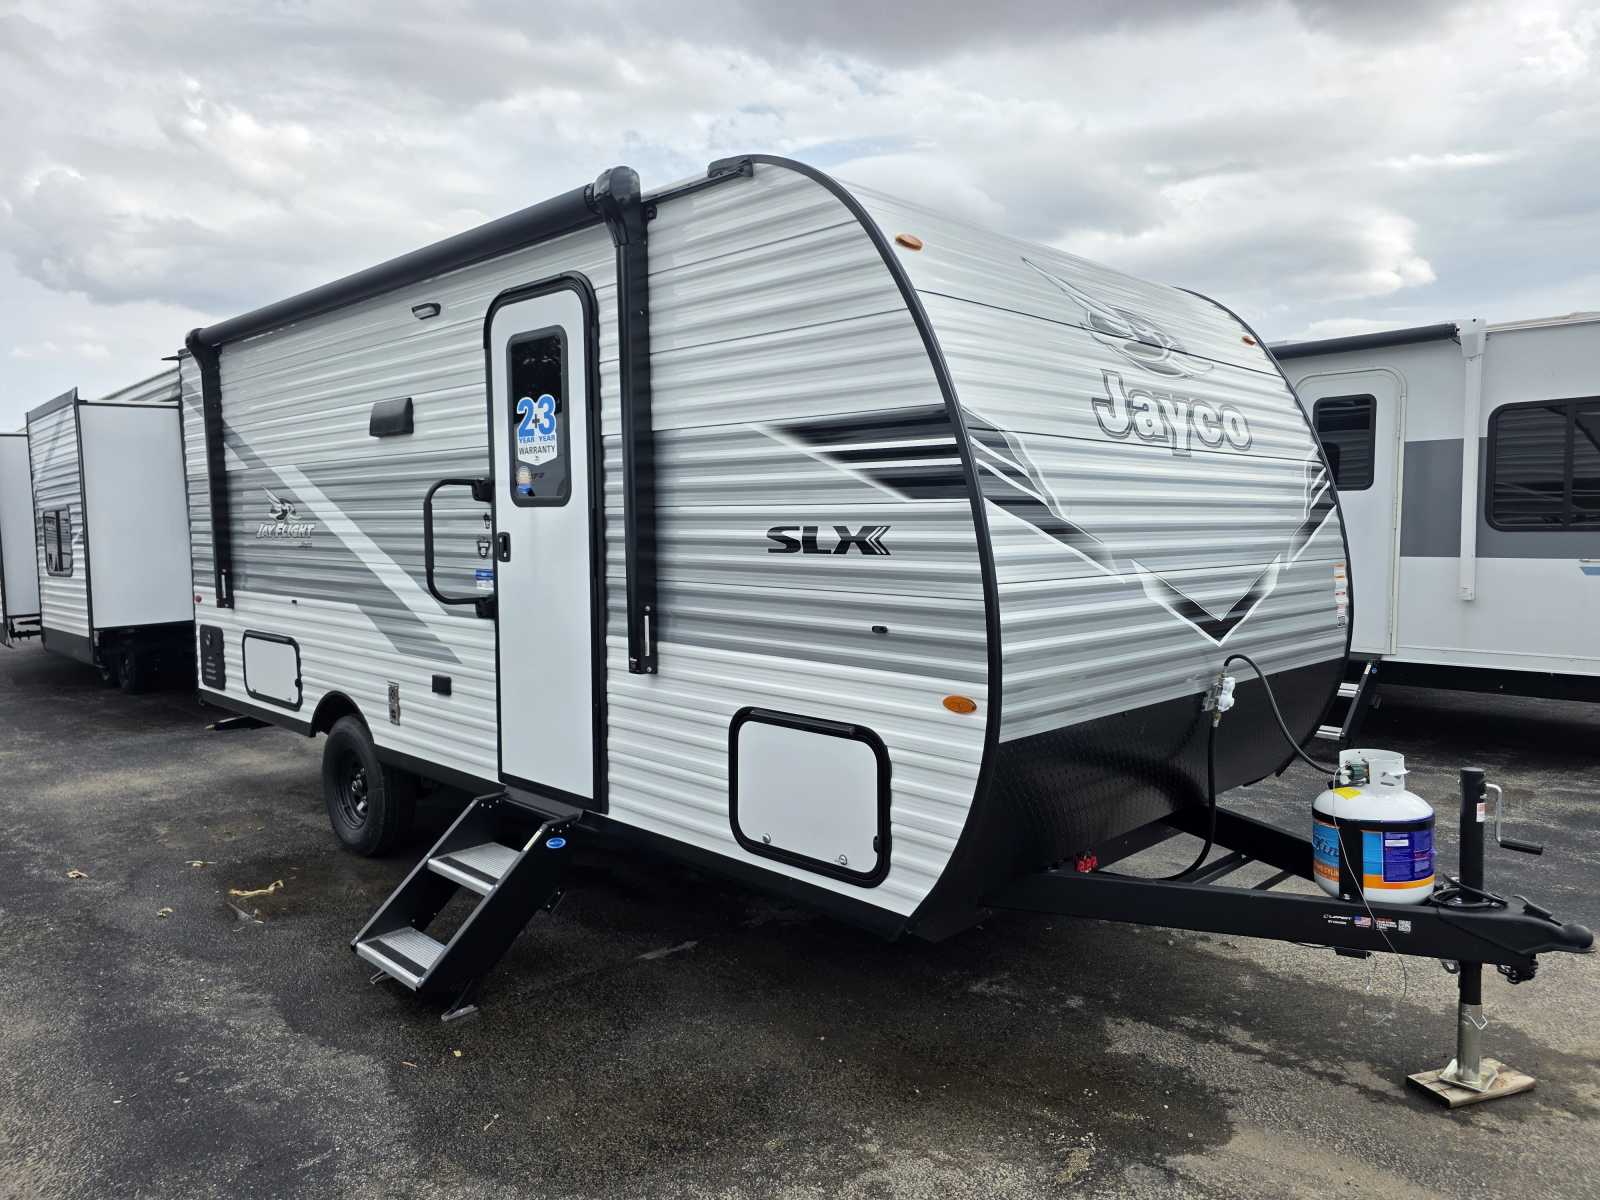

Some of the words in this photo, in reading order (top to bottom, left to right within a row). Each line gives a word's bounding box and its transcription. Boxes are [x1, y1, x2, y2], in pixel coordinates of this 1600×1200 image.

[1092, 369, 1252, 457] Jayco
[539, 434, 556, 442] YEAR
[519, 445, 555, 455] WARRANTY
[255, 523, 276, 538] JAY
[275, 523, 315, 538] FLIGHT
[766, 525, 891, 555] SLX
